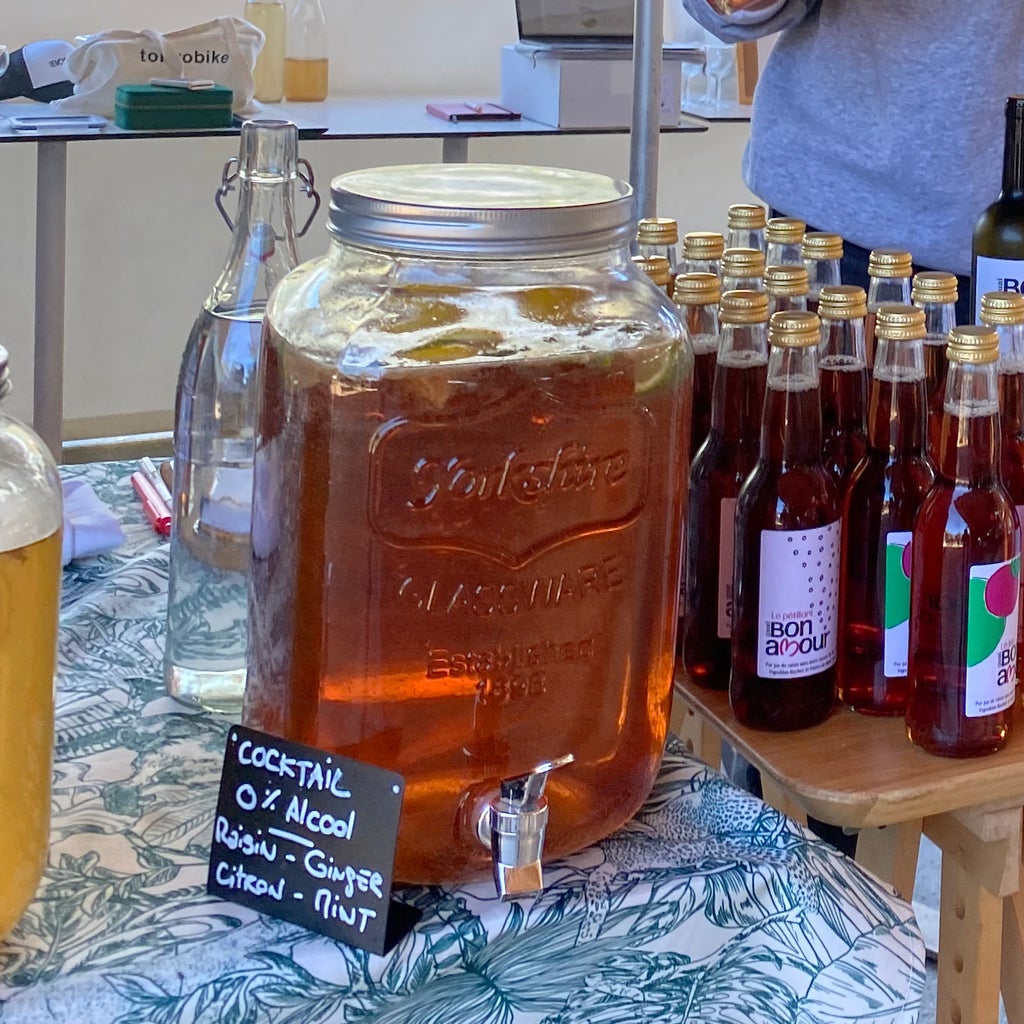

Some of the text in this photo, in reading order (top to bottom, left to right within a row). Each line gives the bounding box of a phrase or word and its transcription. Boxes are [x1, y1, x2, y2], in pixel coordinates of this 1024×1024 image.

[140, 49, 229, 64] toobike
[771, 619, 813, 637] Bon
[765, 630, 830, 657] amour
